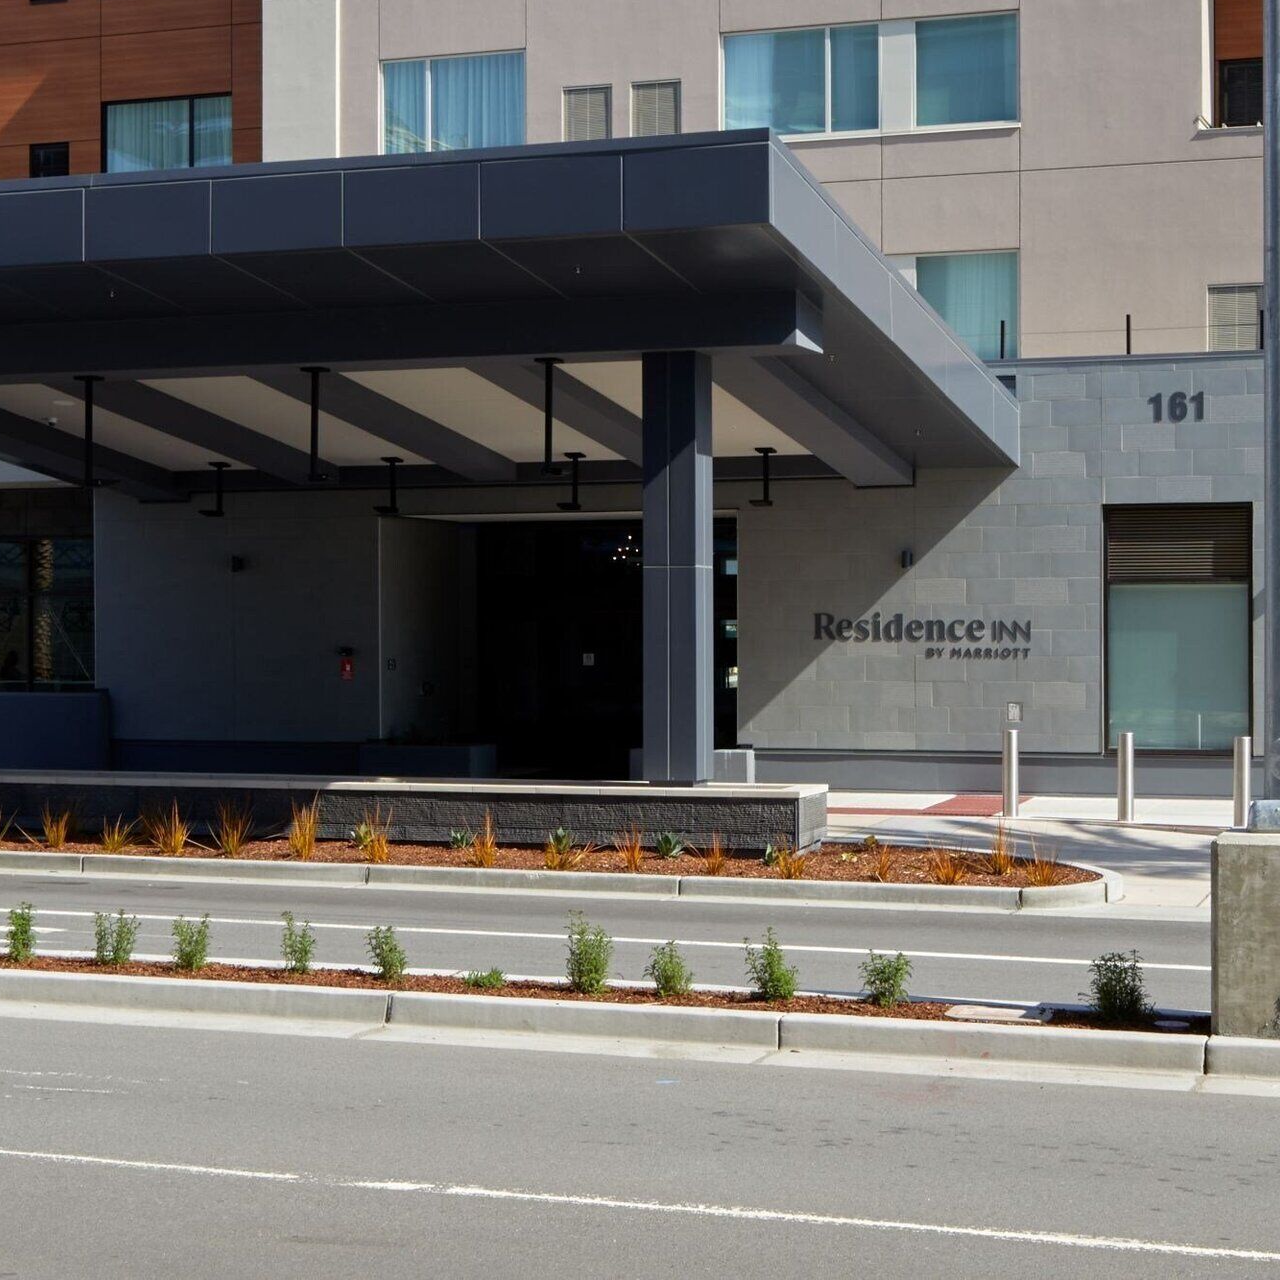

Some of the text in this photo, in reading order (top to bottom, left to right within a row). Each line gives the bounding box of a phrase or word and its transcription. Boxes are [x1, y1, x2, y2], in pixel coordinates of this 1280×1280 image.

[1147, 391, 1204, 424] 161
[813, 611, 1032, 644] Residence INN
[925, 647, 1032, 660] BY MARRIOTT
